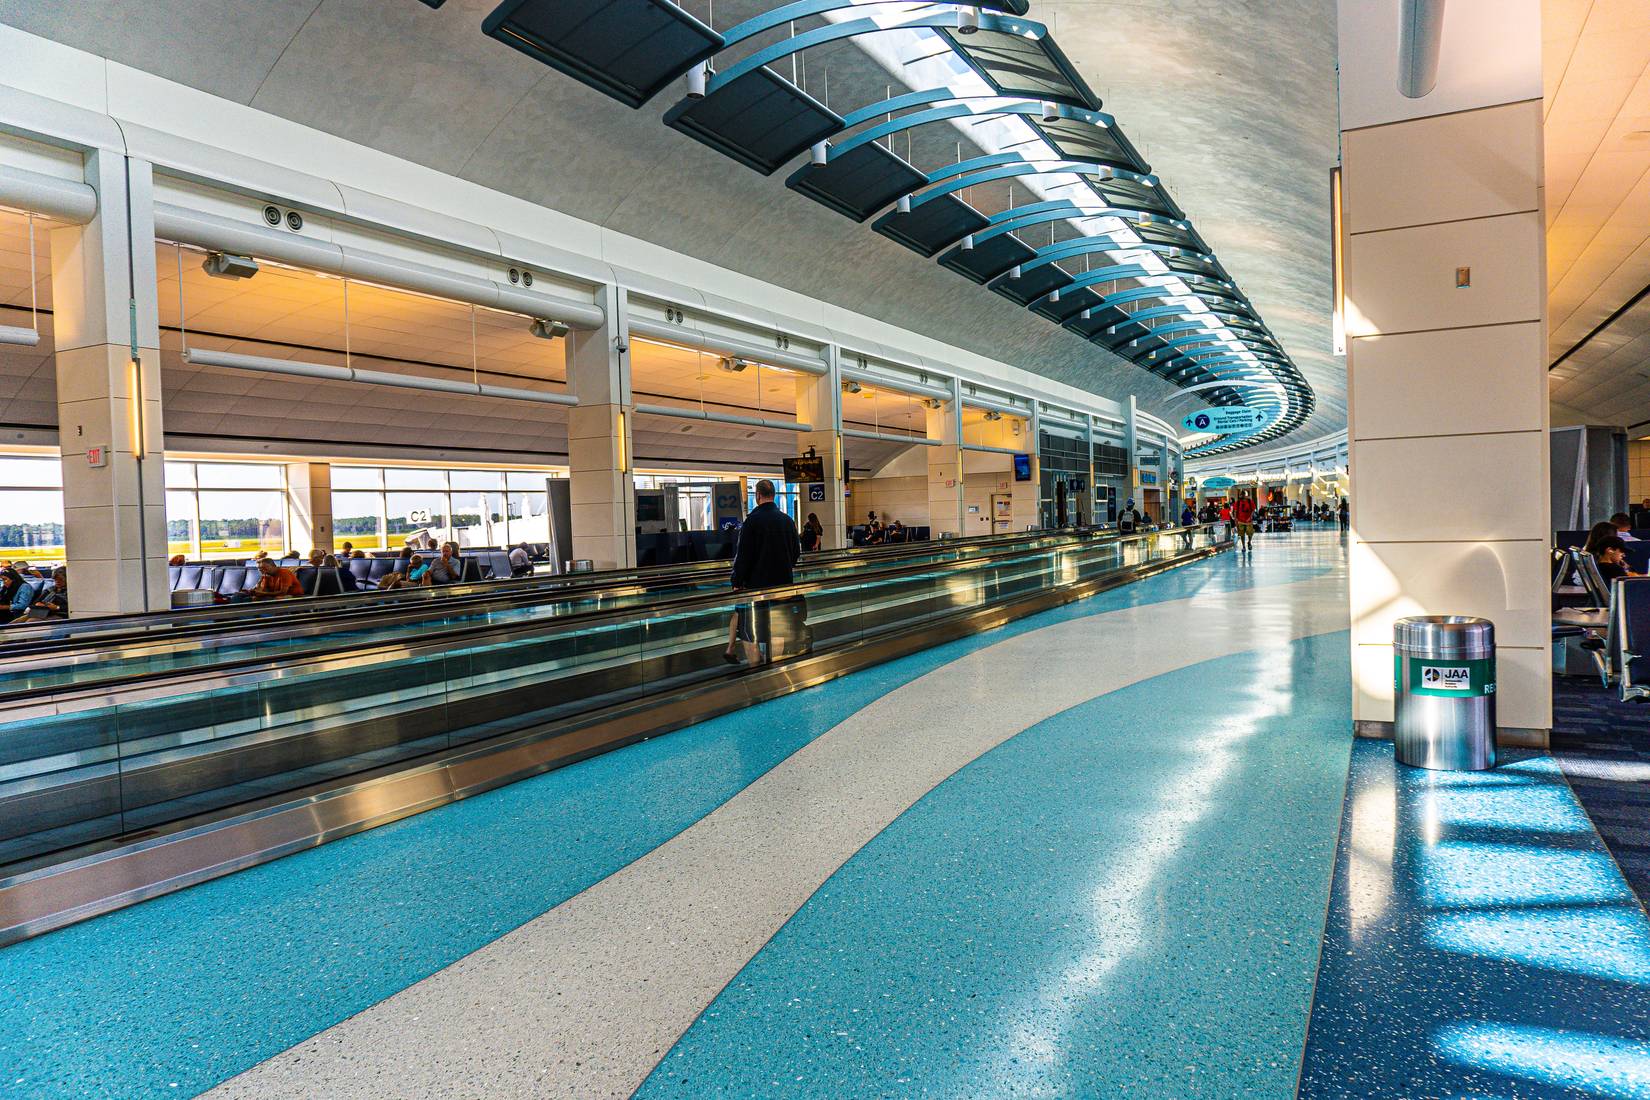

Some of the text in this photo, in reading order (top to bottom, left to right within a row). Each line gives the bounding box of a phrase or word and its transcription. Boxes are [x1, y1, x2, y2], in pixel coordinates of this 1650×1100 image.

[1199, 418, 1206, 426] A
[88, 448, 100, 464] EXIT
[810, 491, 824, 500] C2
[718, 495, 737, 508] C2
[411, 511, 427, 522] C2
[1445, 669, 1468, 679] JAA
[1484, 683, 1496, 694] RE
